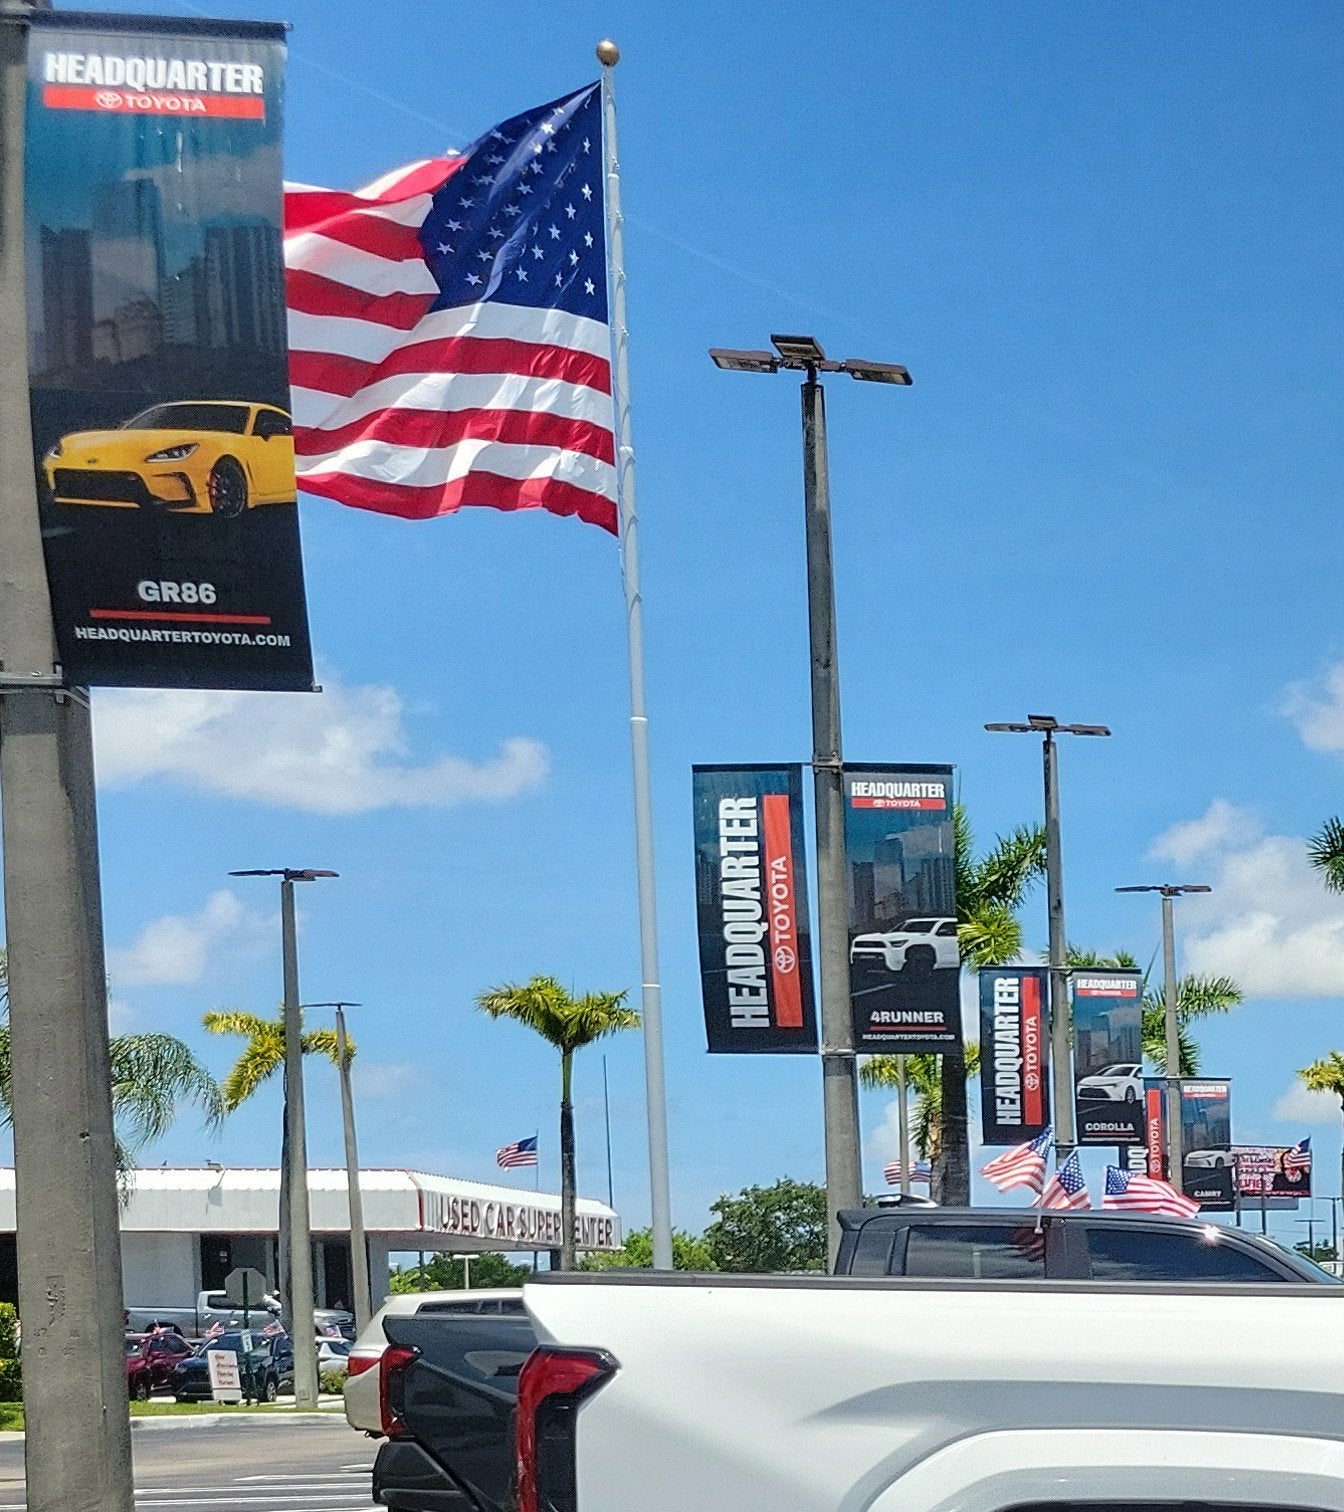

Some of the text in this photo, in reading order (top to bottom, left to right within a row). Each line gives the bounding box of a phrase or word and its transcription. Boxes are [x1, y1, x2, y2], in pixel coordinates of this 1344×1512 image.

[46, 52, 264, 93] HEADQUARTER
[124, 95, 206, 112] TOYOTA
[138, 580, 217, 604] GR86
[75, 627, 290, 647] HEADQUARTERTOYOTA.COM
[851, 782, 945, 798] HEADQUARTER
[885, 799, 921, 807] TOYOTA
[772, 856, 791, 944] TOYOTA
[719, 797, 770, 1028] HEADQUARTER
[870, 1011, 944, 1023] 4RUNNER
[994, 977, 1023, 1125] HEADQUARTER
[1026, 1016, 1038, 1071] TOYOTA
[1085, 1122, 1135, 1131] COROLLA
[440, 1195, 613, 1247] USED CAR SUPERENTER
